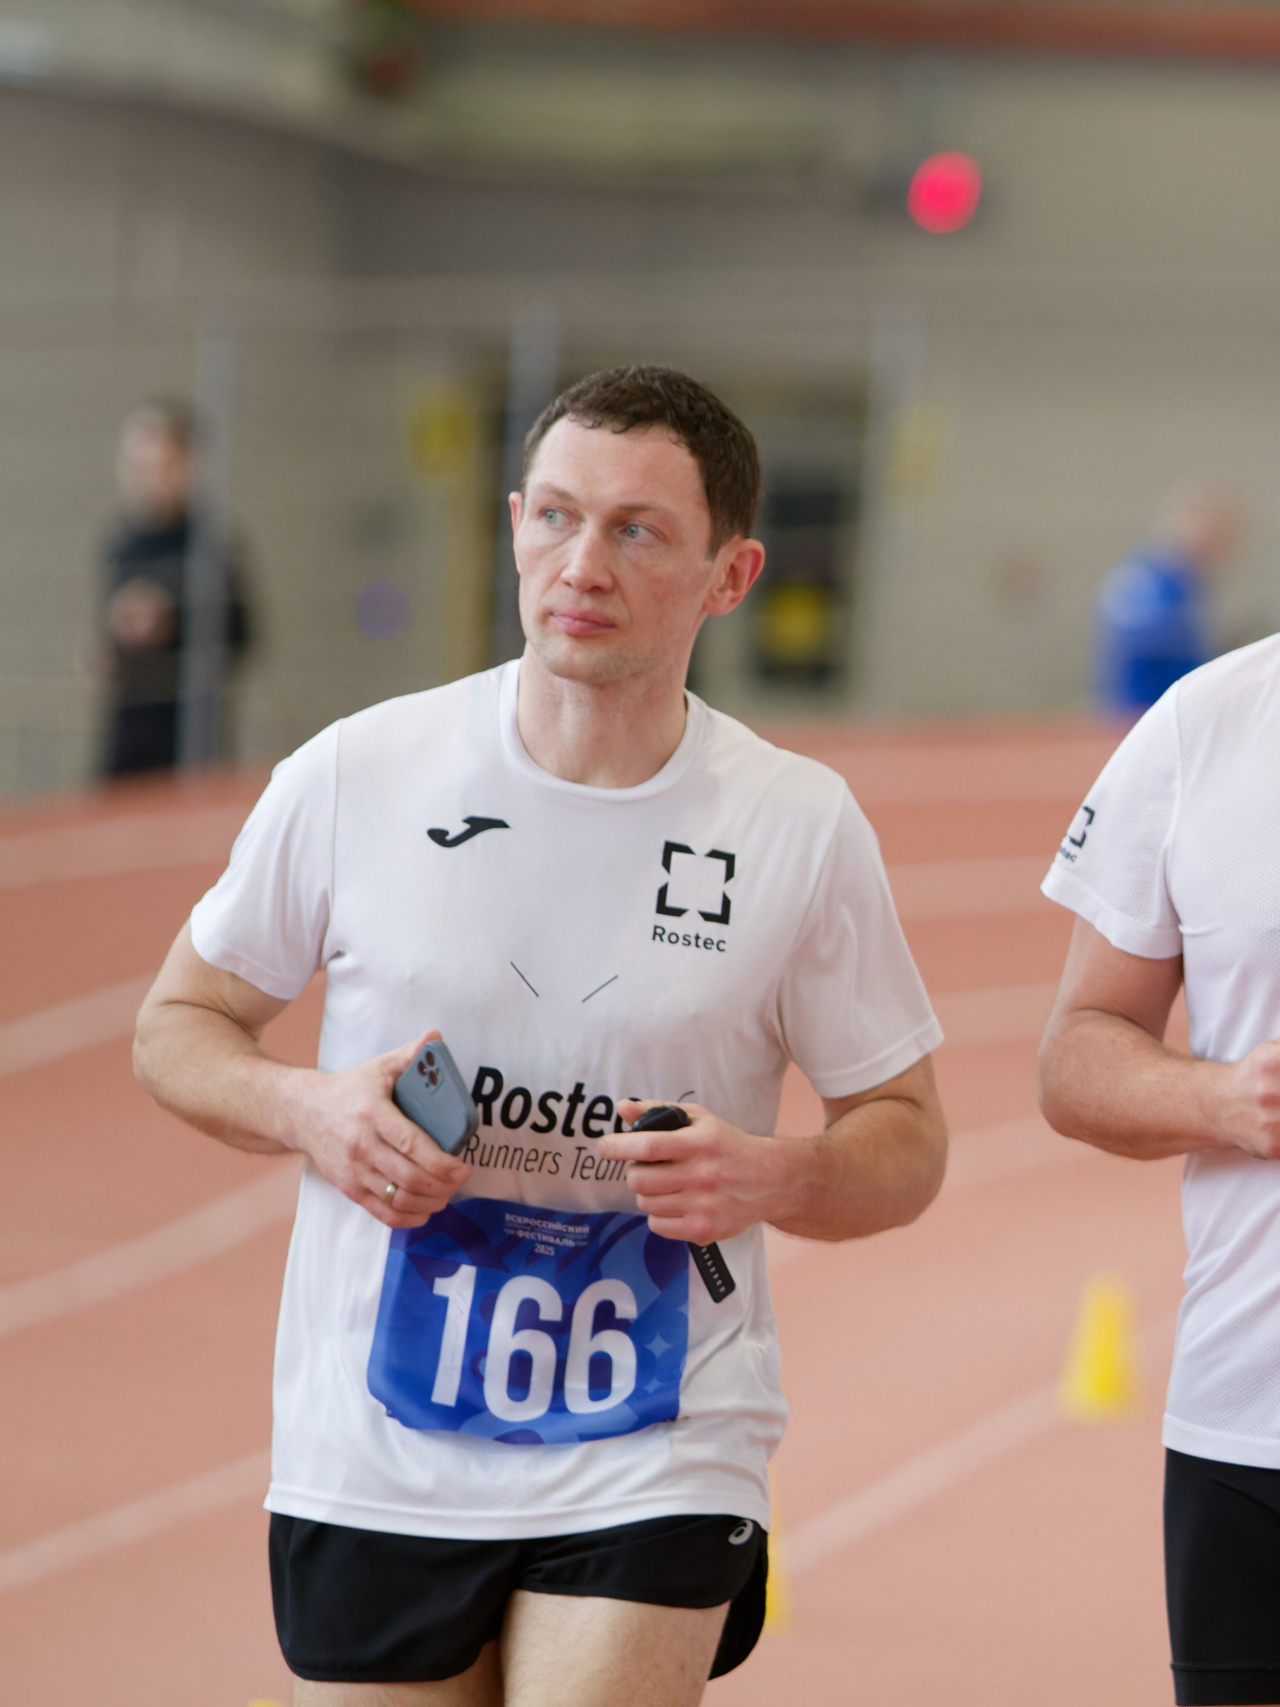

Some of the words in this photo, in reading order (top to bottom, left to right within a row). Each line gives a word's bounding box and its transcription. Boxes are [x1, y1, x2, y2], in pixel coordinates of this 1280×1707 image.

[652, 925, 727, 952] Rostec
[465, 1135, 562, 1176] Runners
[432, 1264, 636, 1421] 166
